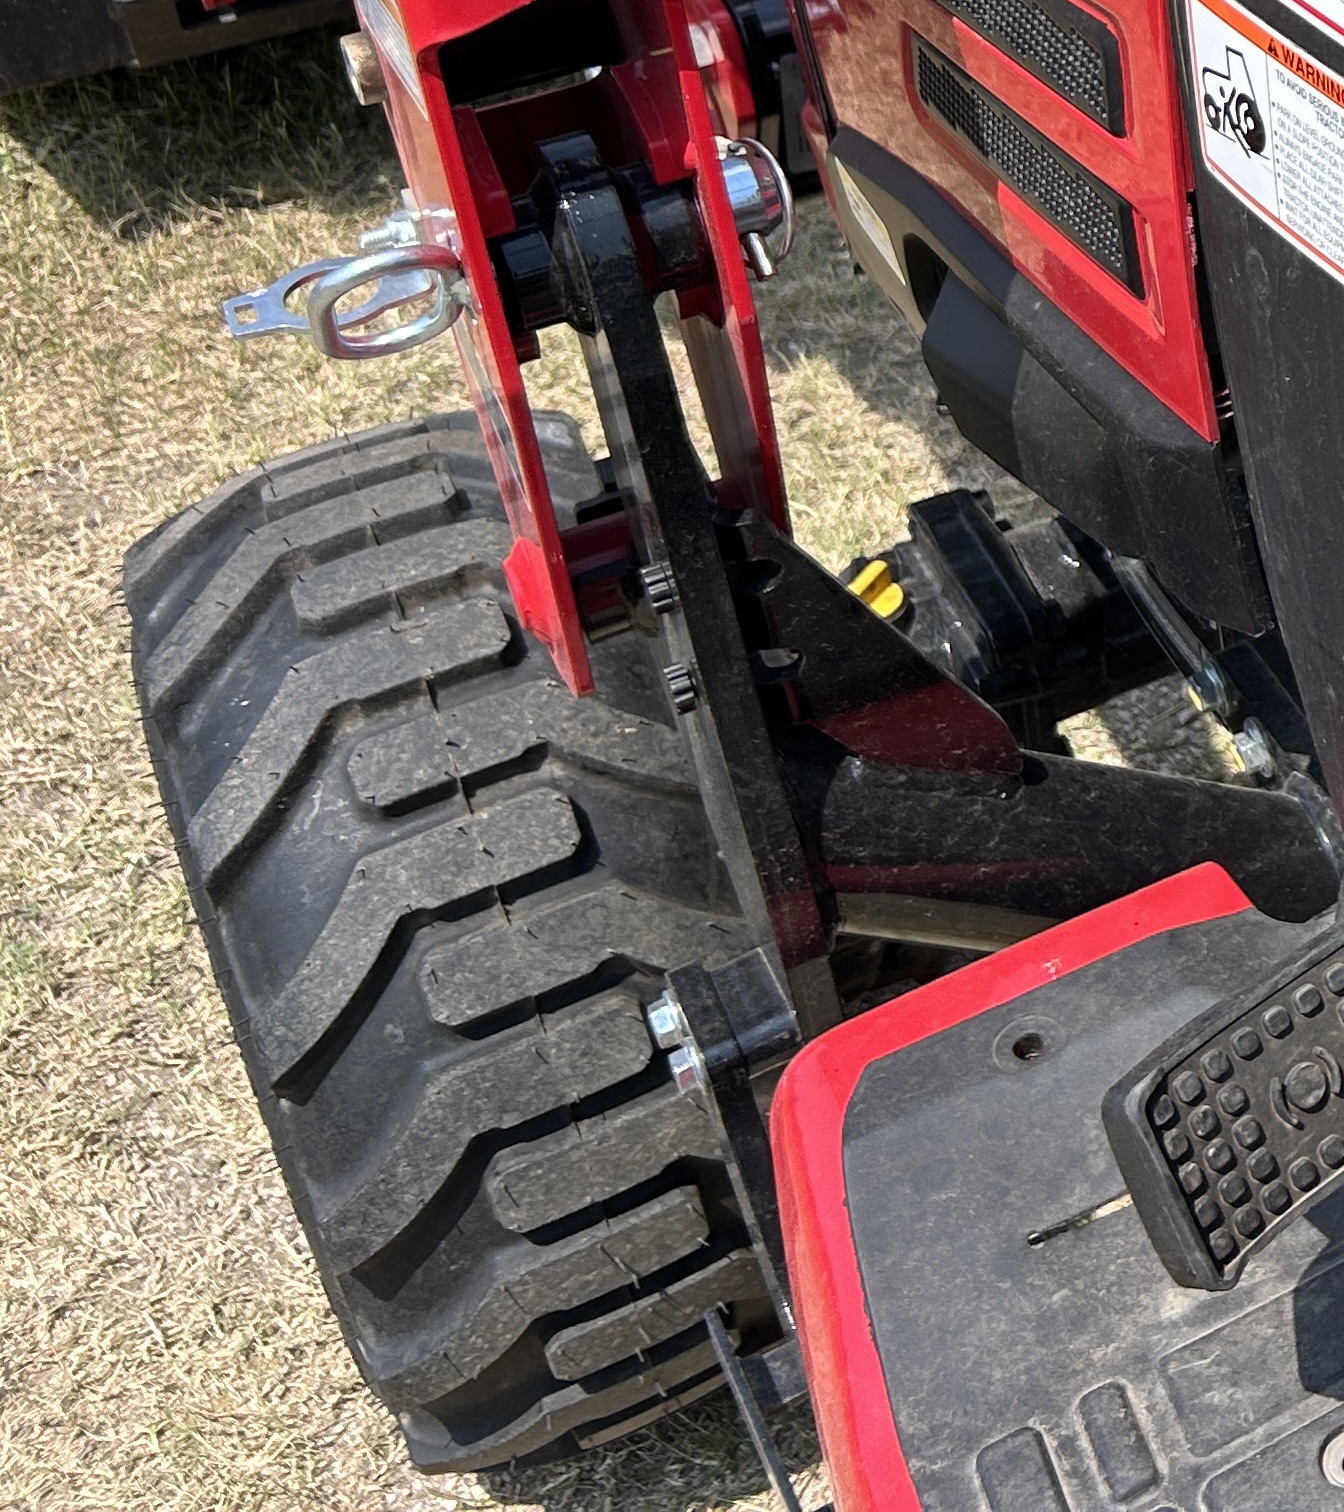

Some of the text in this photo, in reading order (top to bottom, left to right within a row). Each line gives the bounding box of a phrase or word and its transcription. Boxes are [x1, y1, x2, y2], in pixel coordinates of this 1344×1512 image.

[1275, 68, 1286, 85] TO
[1285, 75, 1307, 101] AVOID
[1308, 91, 1338, 123] SERIOUS
